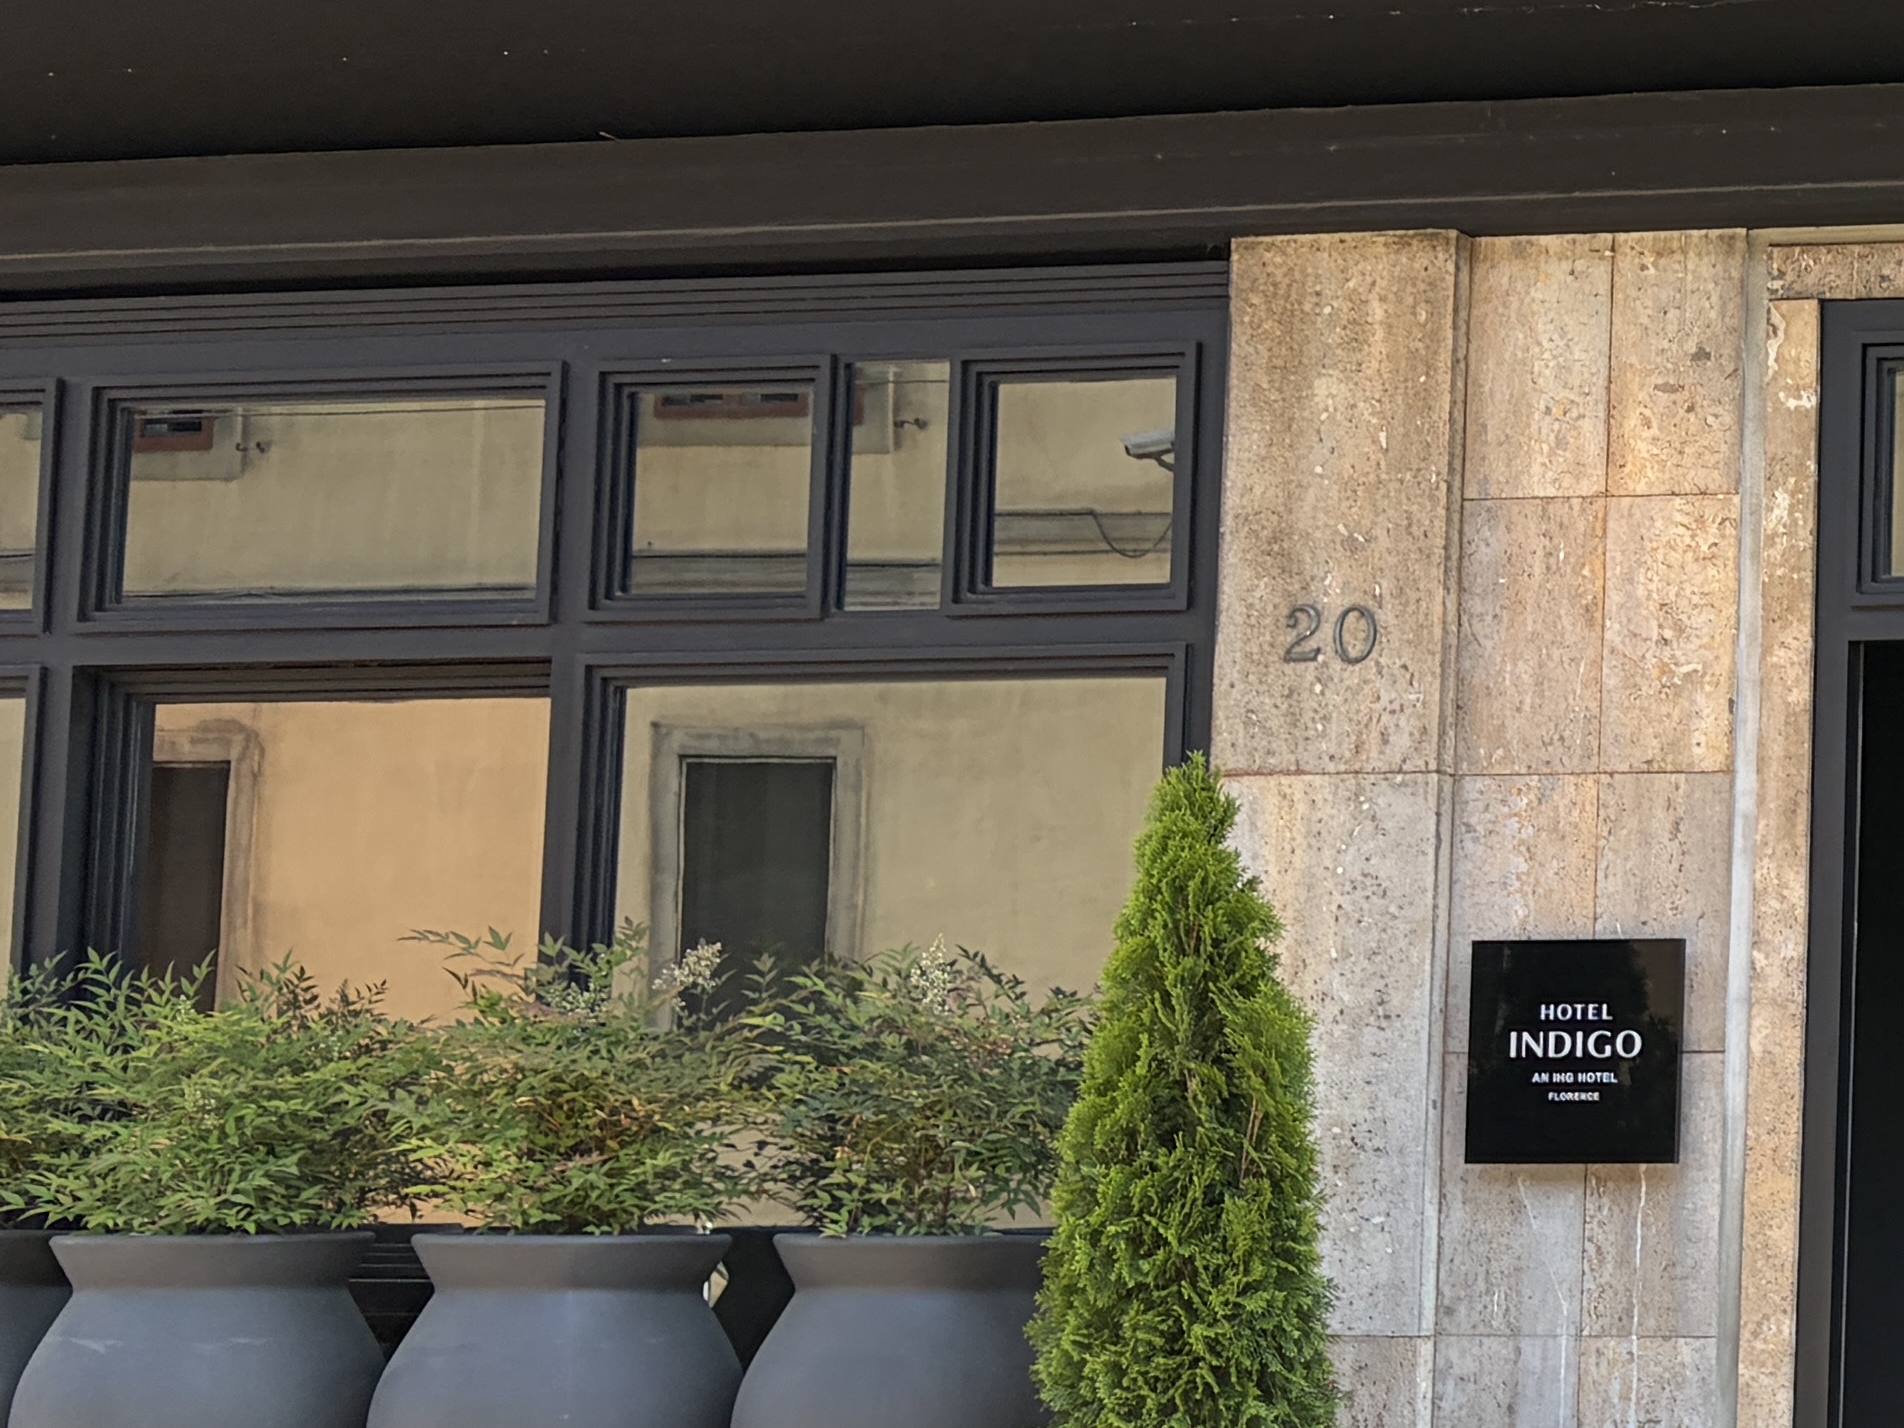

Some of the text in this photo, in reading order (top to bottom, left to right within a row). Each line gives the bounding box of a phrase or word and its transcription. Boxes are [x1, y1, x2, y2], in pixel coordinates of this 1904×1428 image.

[1282, 604, 1379, 665] 20
[1540, 1003, 1613, 1021] HOTEL
[1509, 1029, 1643, 1059] INDIGO
[1531, 1072, 1618, 1084] AN IHG HOTEL
[1548, 1092, 1600, 1101] FLORENCE
